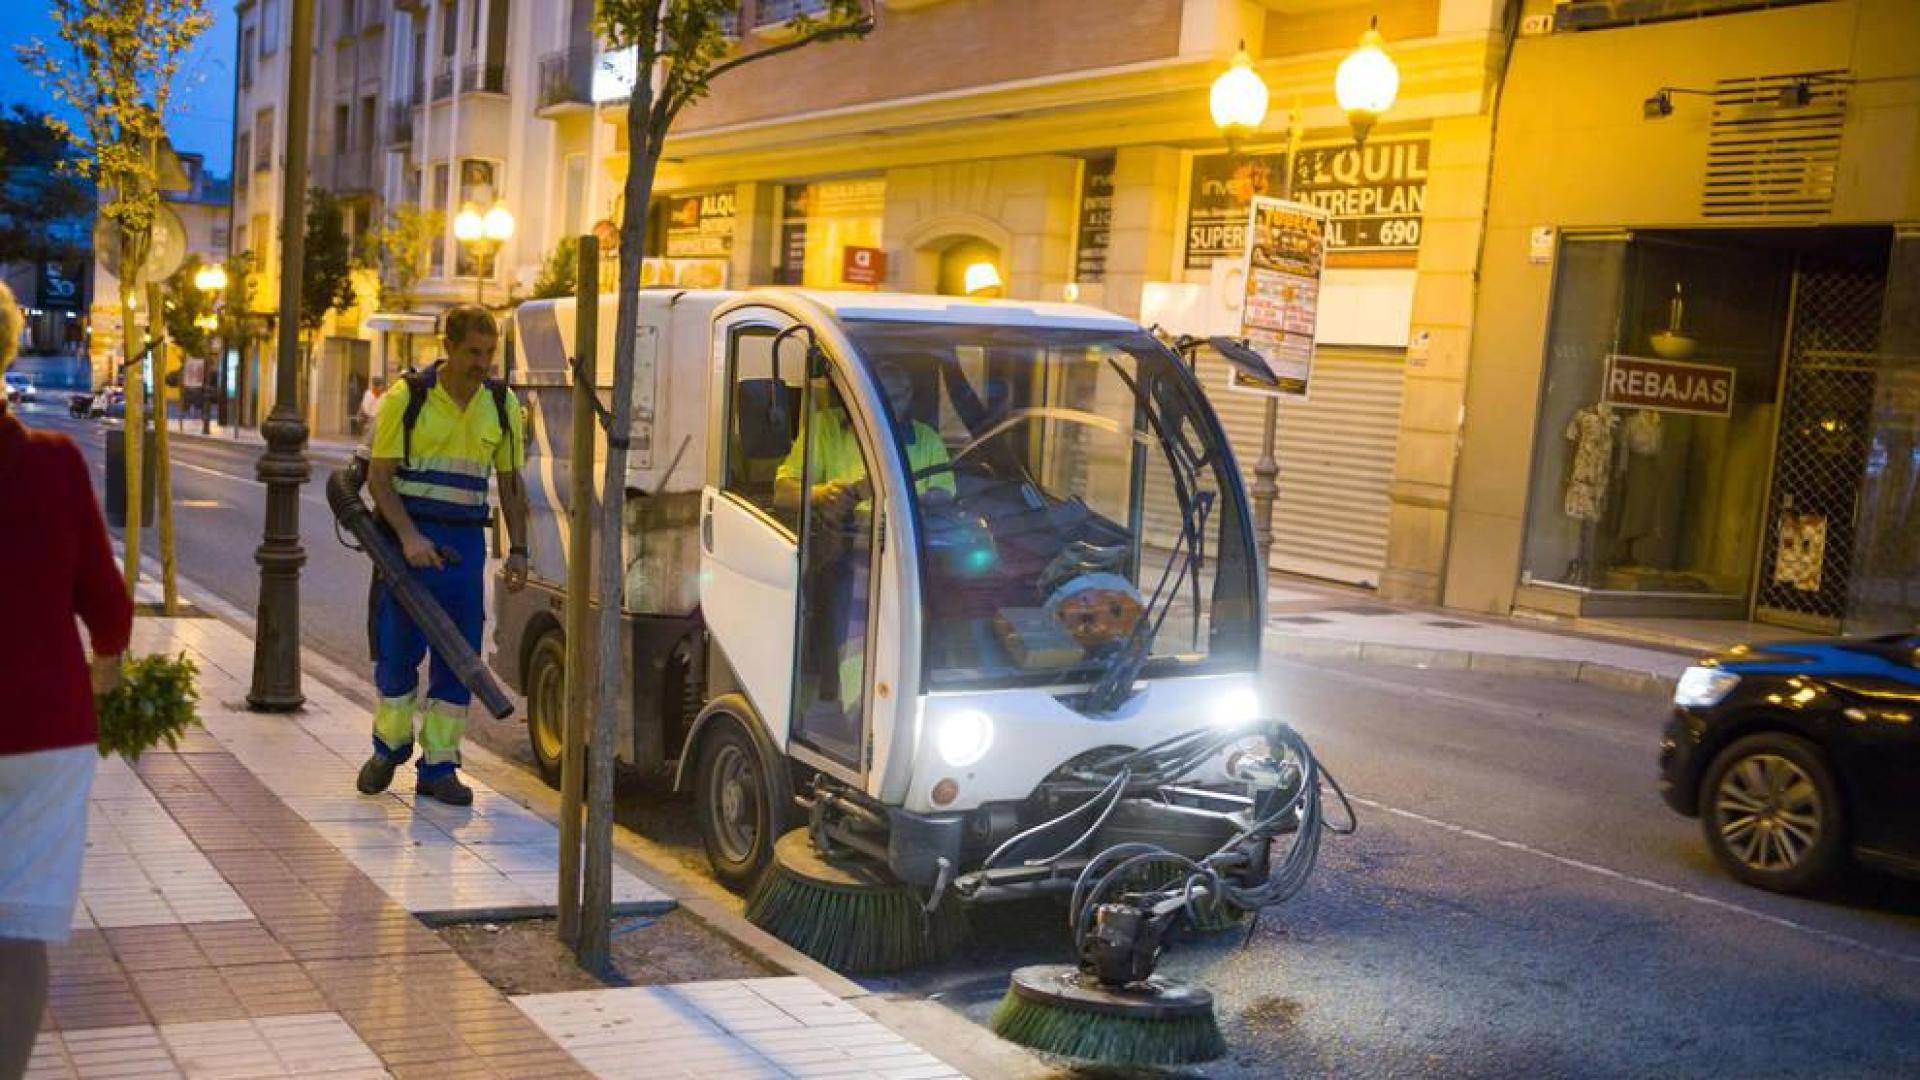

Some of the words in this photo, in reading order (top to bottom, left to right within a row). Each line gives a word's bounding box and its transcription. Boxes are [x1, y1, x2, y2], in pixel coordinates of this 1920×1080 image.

[1293, 185, 1427, 215] NTREPLAN
[1380, 220, 1419, 245] 690
[1609, 367, 1728, 404] REBAJAS
